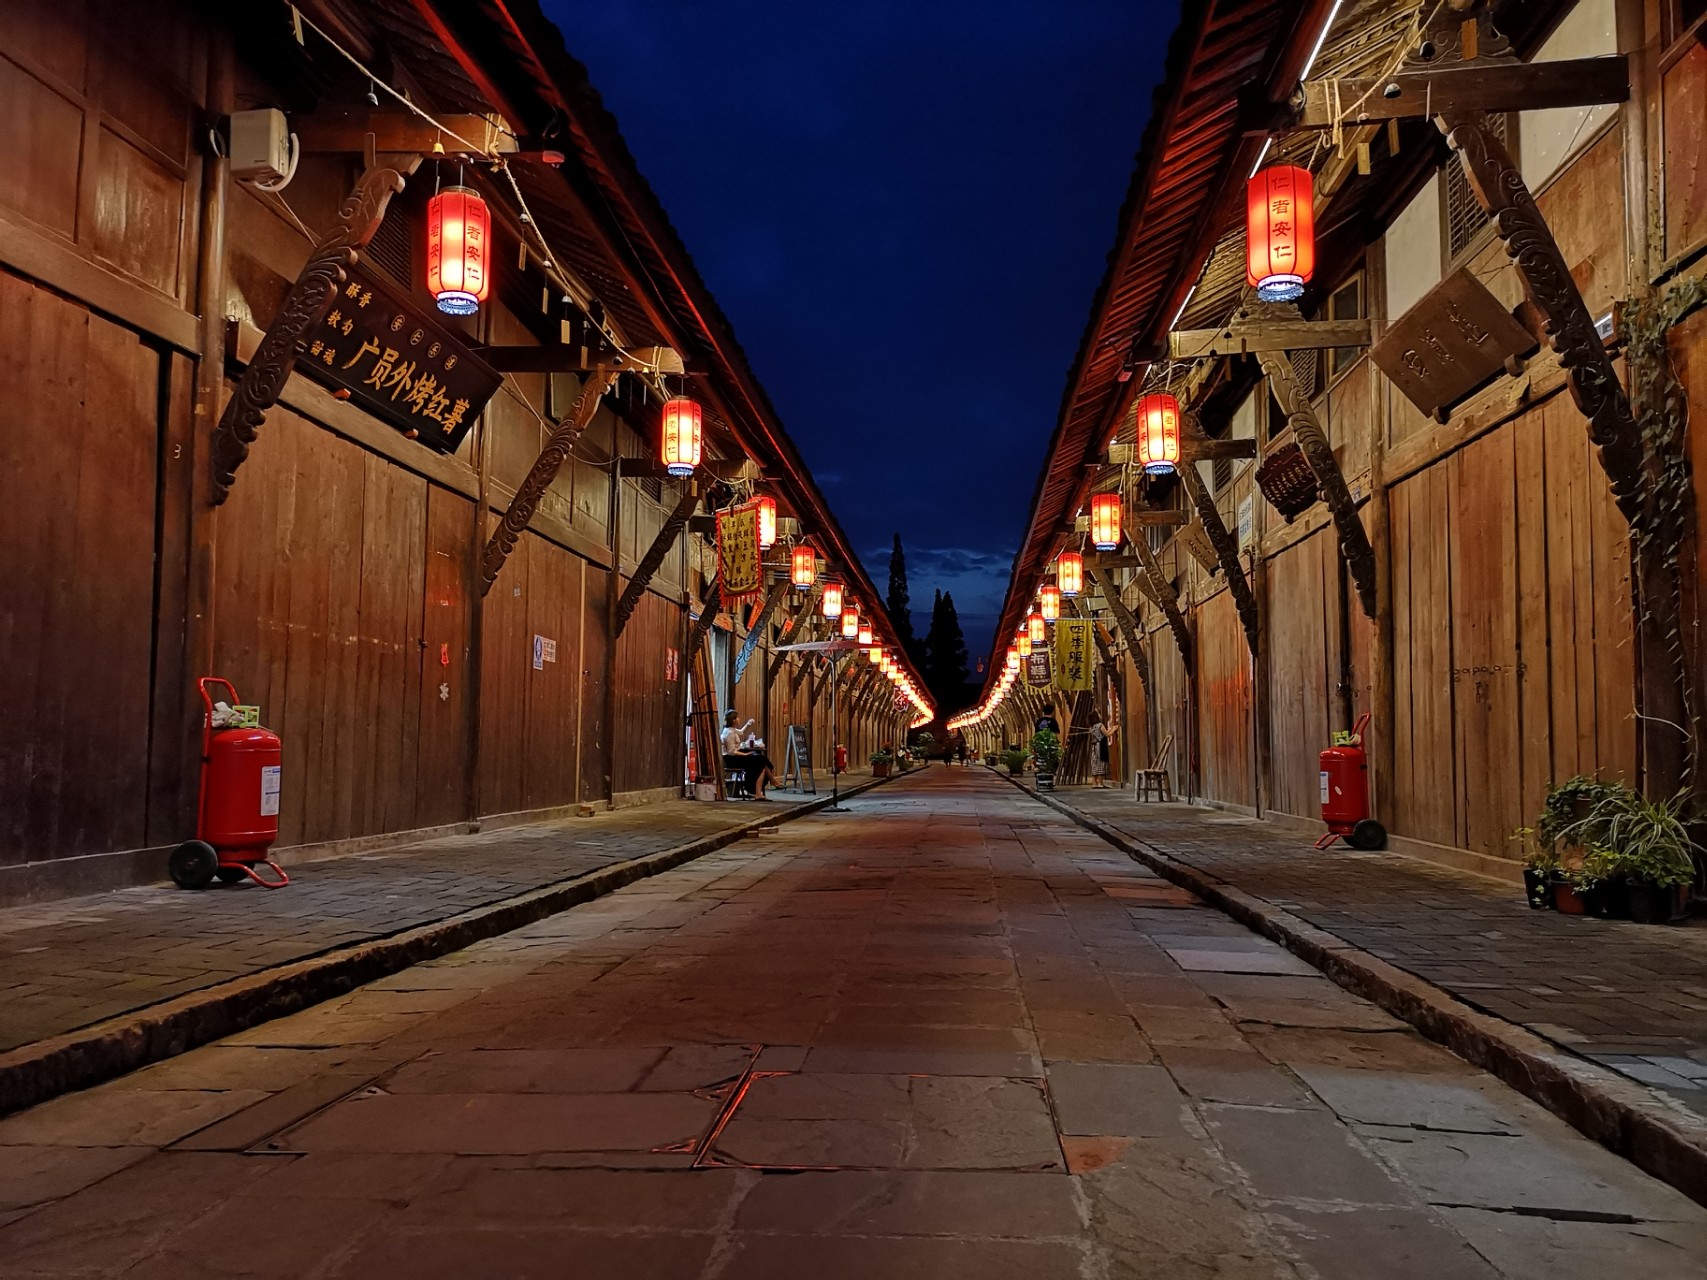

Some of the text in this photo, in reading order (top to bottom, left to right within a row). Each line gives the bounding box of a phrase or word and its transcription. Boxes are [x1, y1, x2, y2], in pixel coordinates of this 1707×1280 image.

[466, 204, 482, 280] 仁者安仁
[1271, 177, 1293, 259] 仁者安仁
[341, 336, 470, 435] 广员外烤红薯
[1030, 653, 1047, 675] 布鞋
[1068, 625, 1085, 681] 四季服装
